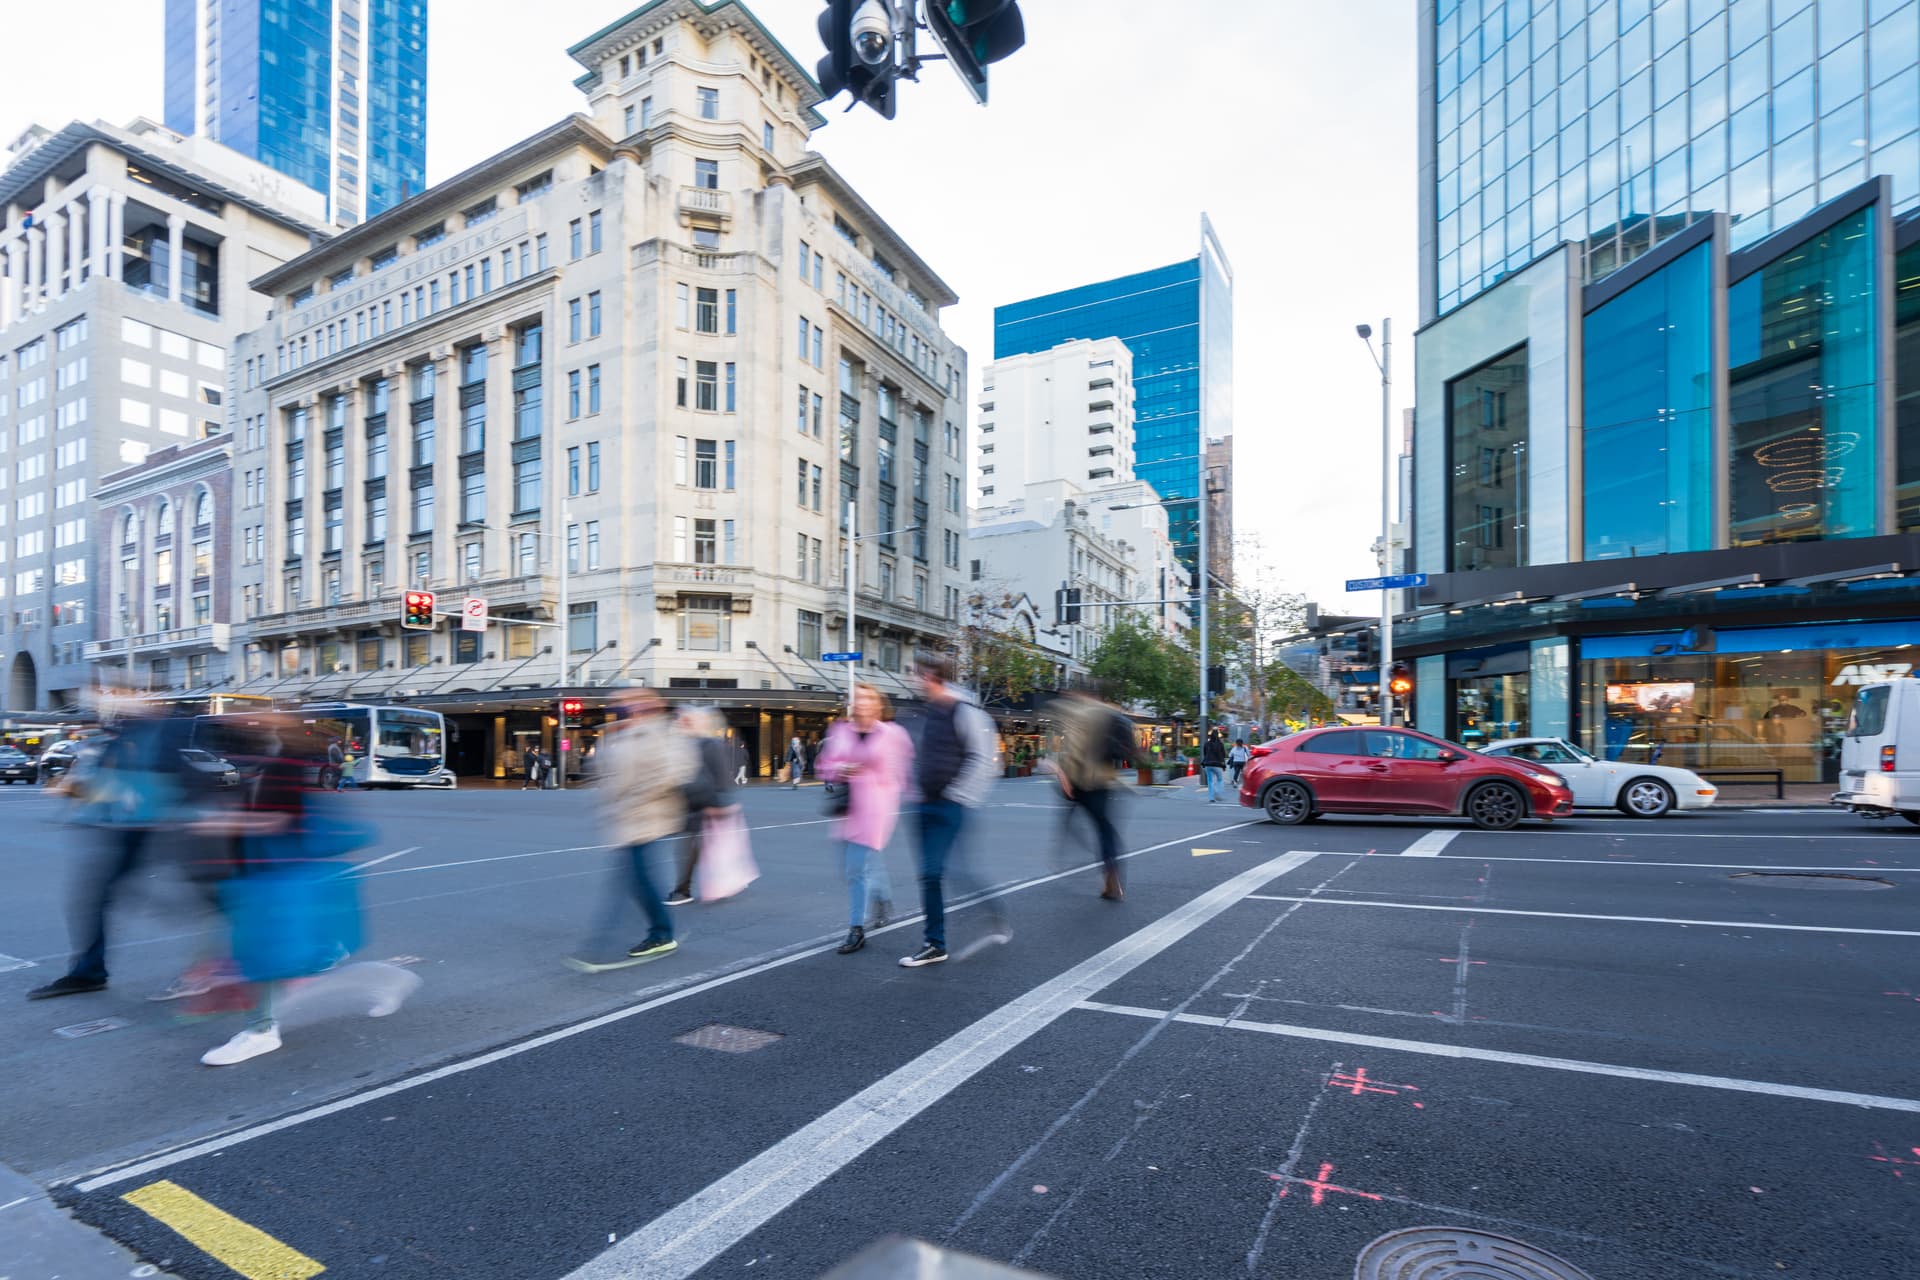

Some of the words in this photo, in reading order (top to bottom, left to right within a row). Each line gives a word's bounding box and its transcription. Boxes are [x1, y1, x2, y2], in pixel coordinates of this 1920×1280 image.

[403, 226, 501, 281] BUILDING
[1347, 578, 1385, 590] CUSTOMS
[1831, 663, 1912, 686] ANZ
